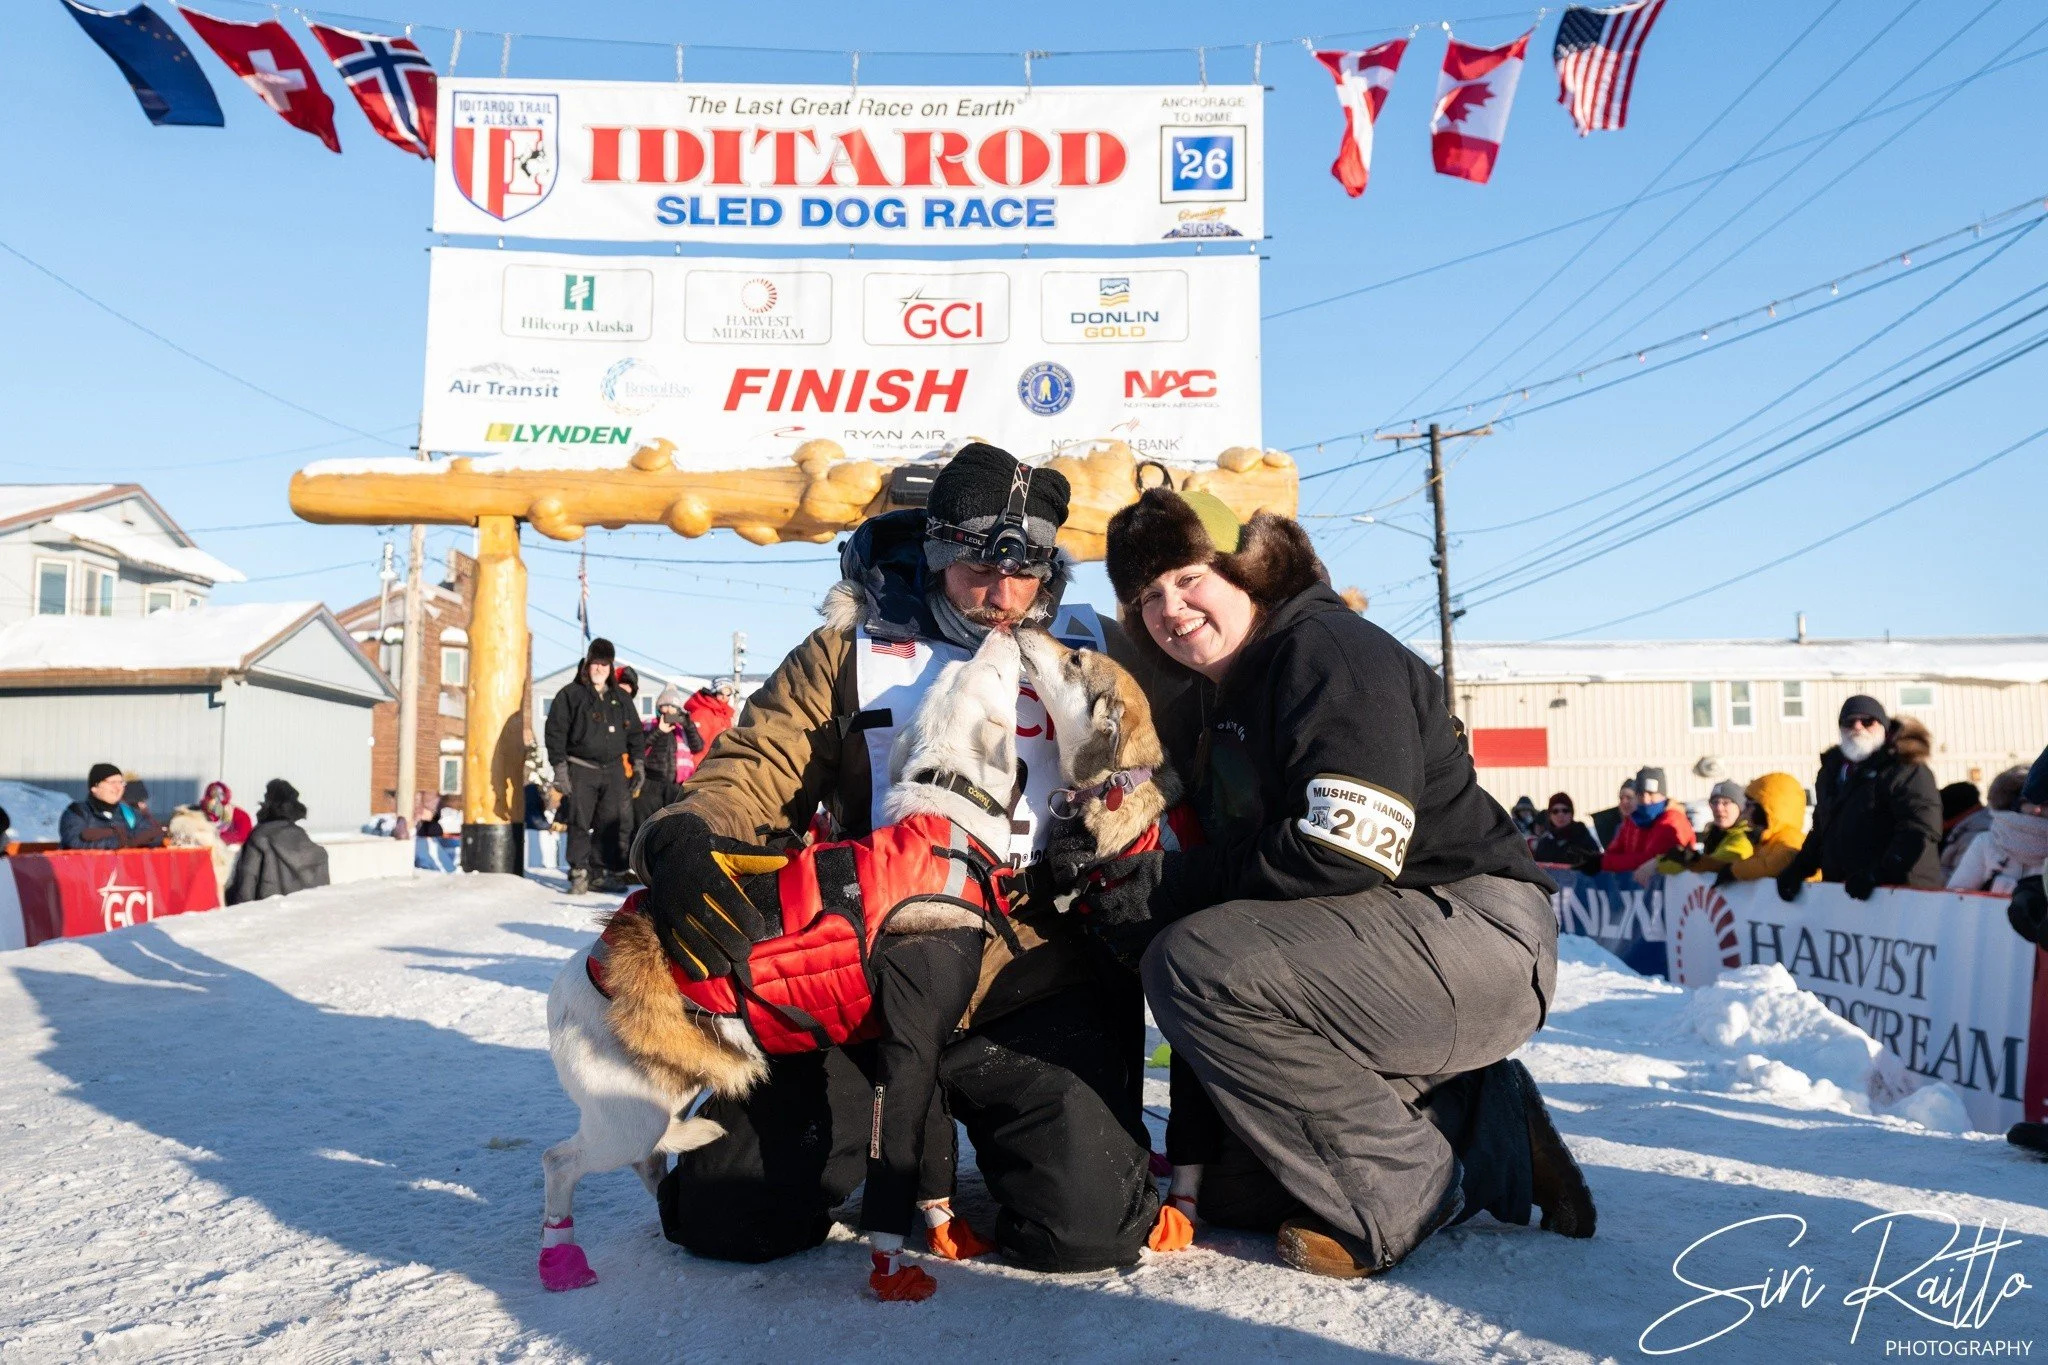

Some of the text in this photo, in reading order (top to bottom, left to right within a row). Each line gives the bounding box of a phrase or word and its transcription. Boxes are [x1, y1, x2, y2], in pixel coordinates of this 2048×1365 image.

[459, 99, 552, 114] IDITAROD TRAIL
[688, 95, 727, 115] The
[735, 95, 782, 116] Last
[791, 96, 852, 116] Great
[858, 98, 913, 118] Race
[921, 103, 948, 118] on
[1161, 96, 1245, 108] ANCHORAGE
[483, 113, 529, 126] ALASKA
[1173, 112, 1232, 122] TO NOME
[582, 123, 1131, 190] IDITAROD
[655, 195, 1057, 229] SLED DOG RACE
[1181, 222, 1224, 236] SIGNS
[521, 315, 634, 334] Hilcorp Alaska
[726, 314, 793, 328] HARVEST
[903, 301, 982, 340] GCI
[1071, 310, 1160, 325] DONLIN
[712, 327, 805, 341] MIDSTREAM
[1084, 325, 1146, 339] GOLD
[448, 379, 560, 398] Air Transit
[723, 368, 969, 413] FINISH
[1124, 369, 1218, 398] NAC
[512, 423, 633, 445] LYNDEN
[844, 429, 946, 440] RYAN AIR
[1138, 439, 1180, 451] BANK
[1313, 787, 1368, 806] MUSHER
[1372, 800, 1413, 833] HANDLER
[1329, 808, 1406, 867] 2026
